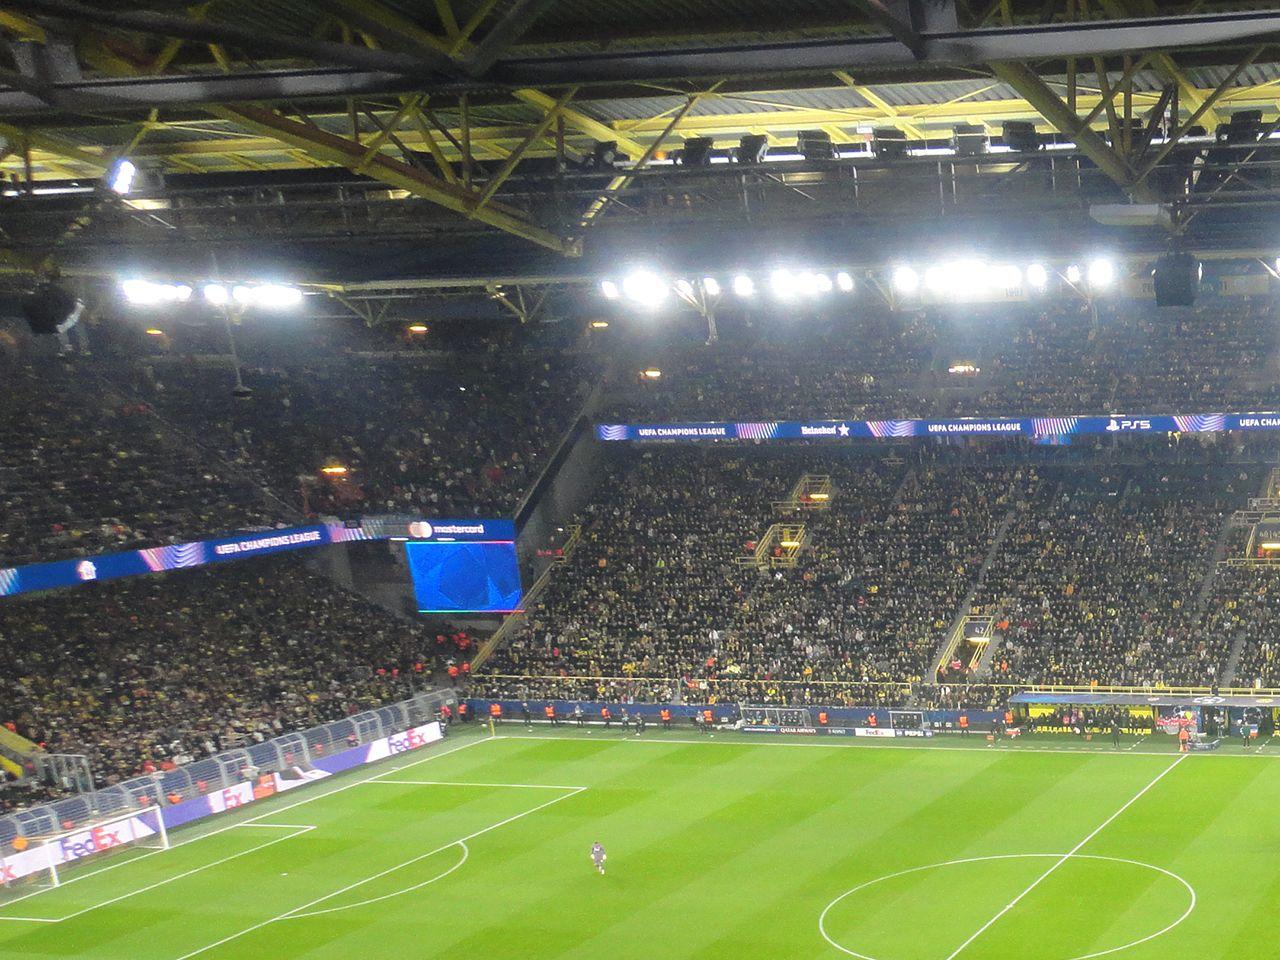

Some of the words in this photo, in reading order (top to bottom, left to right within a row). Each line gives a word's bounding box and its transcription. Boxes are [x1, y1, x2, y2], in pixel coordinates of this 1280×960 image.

[928, 424, 948, 432] UEFA
[948, 423, 992, 432] CHAMPIONS
[993, 422, 1021, 431] LEAGUE
[1121, 420, 1151, 430] PS5
[1239, 418, 1260, 427] UEFA
[639, 428, 658, 436] UEFA
[657, 427, 699, 436] CHAMPIONS
[699, 426, 726, 435] LEAGUE
[801, 425, 837, 435] Heineken
[433, 524, 485, 534] mastercard
[214, 544, 241, 555] UEFA
[240, 536, 290, 552] CHAMPIONS
[289, 531, 321, 544] LEAGUE
[388, 728, 426, 755] FedEx
[60, 827, 122, 861] FedEx
